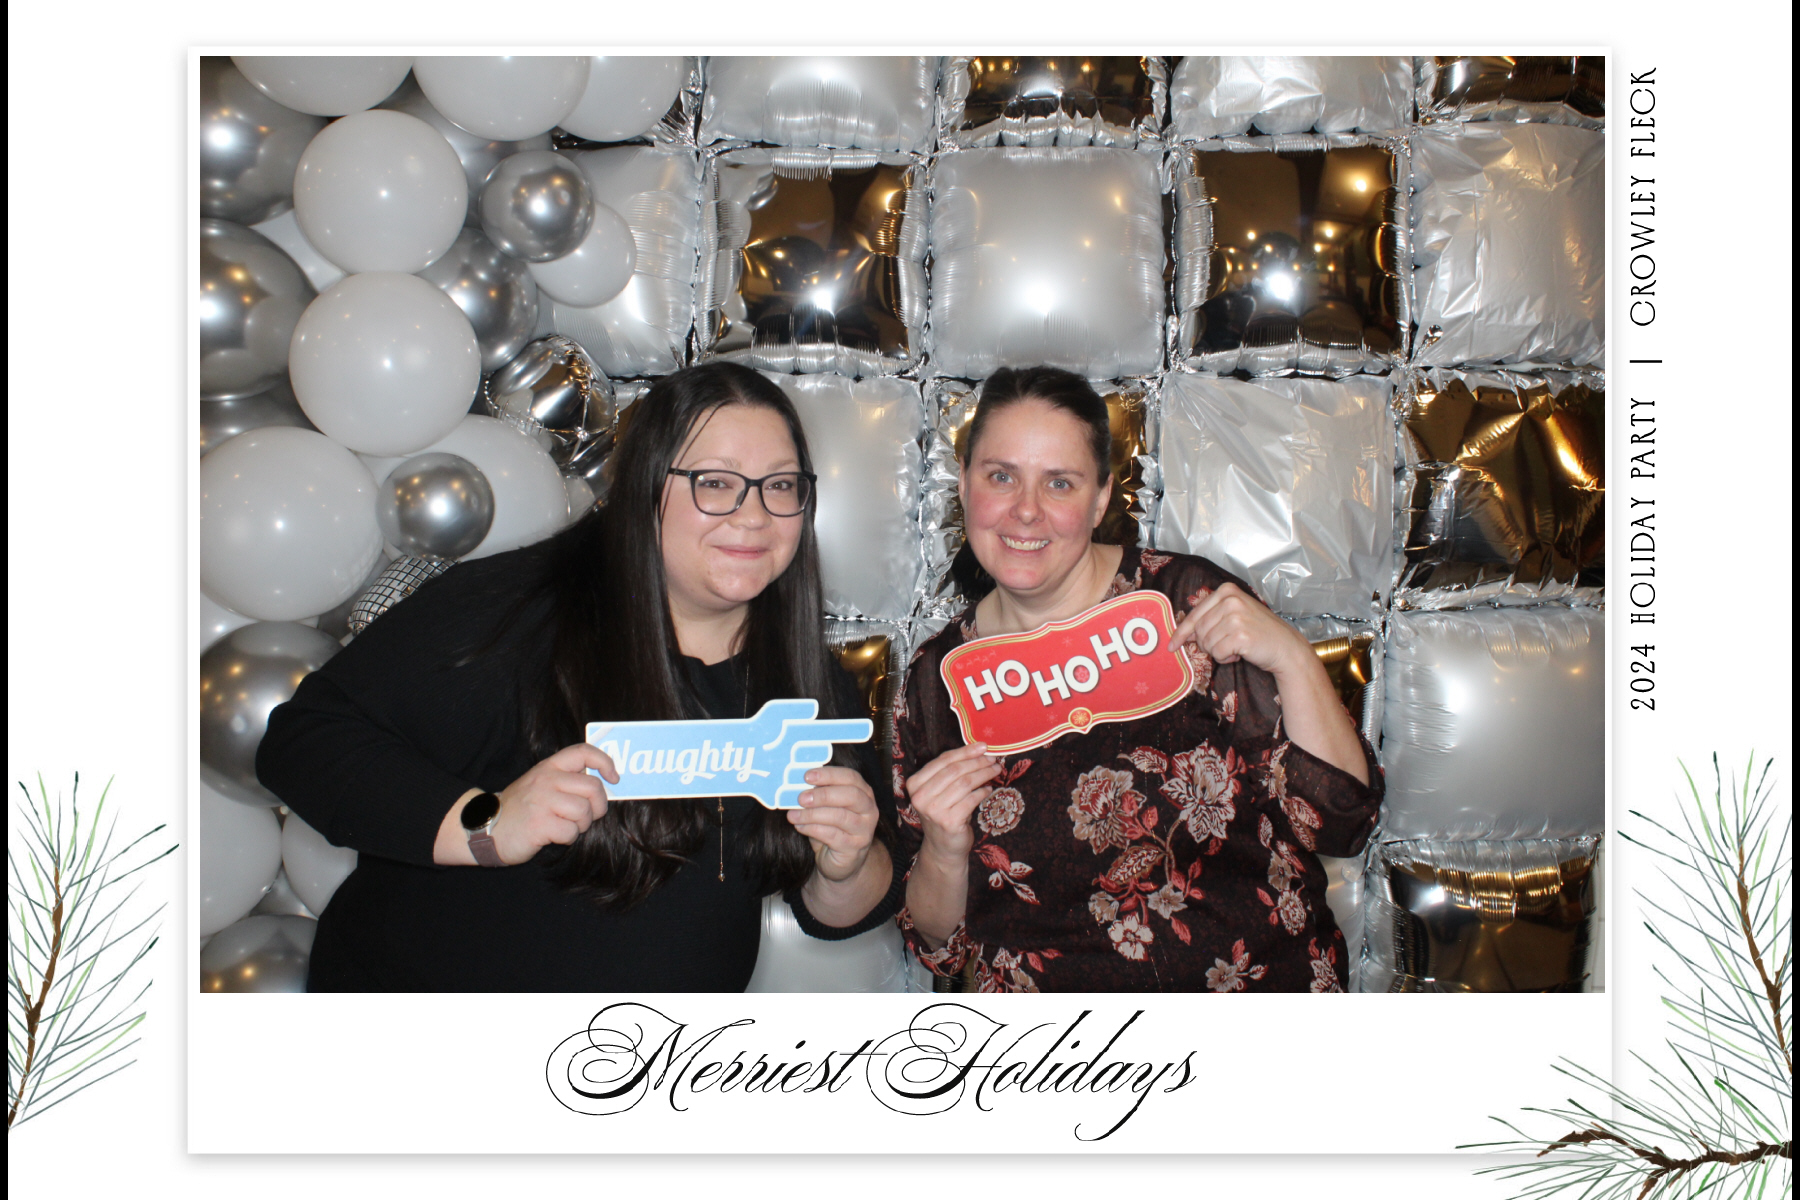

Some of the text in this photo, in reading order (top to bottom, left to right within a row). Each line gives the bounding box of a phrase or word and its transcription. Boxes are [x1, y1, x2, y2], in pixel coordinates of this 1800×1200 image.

[963, 617, 1159, 711] HO HO HO
[599, 738, 771, 786] Naughty
